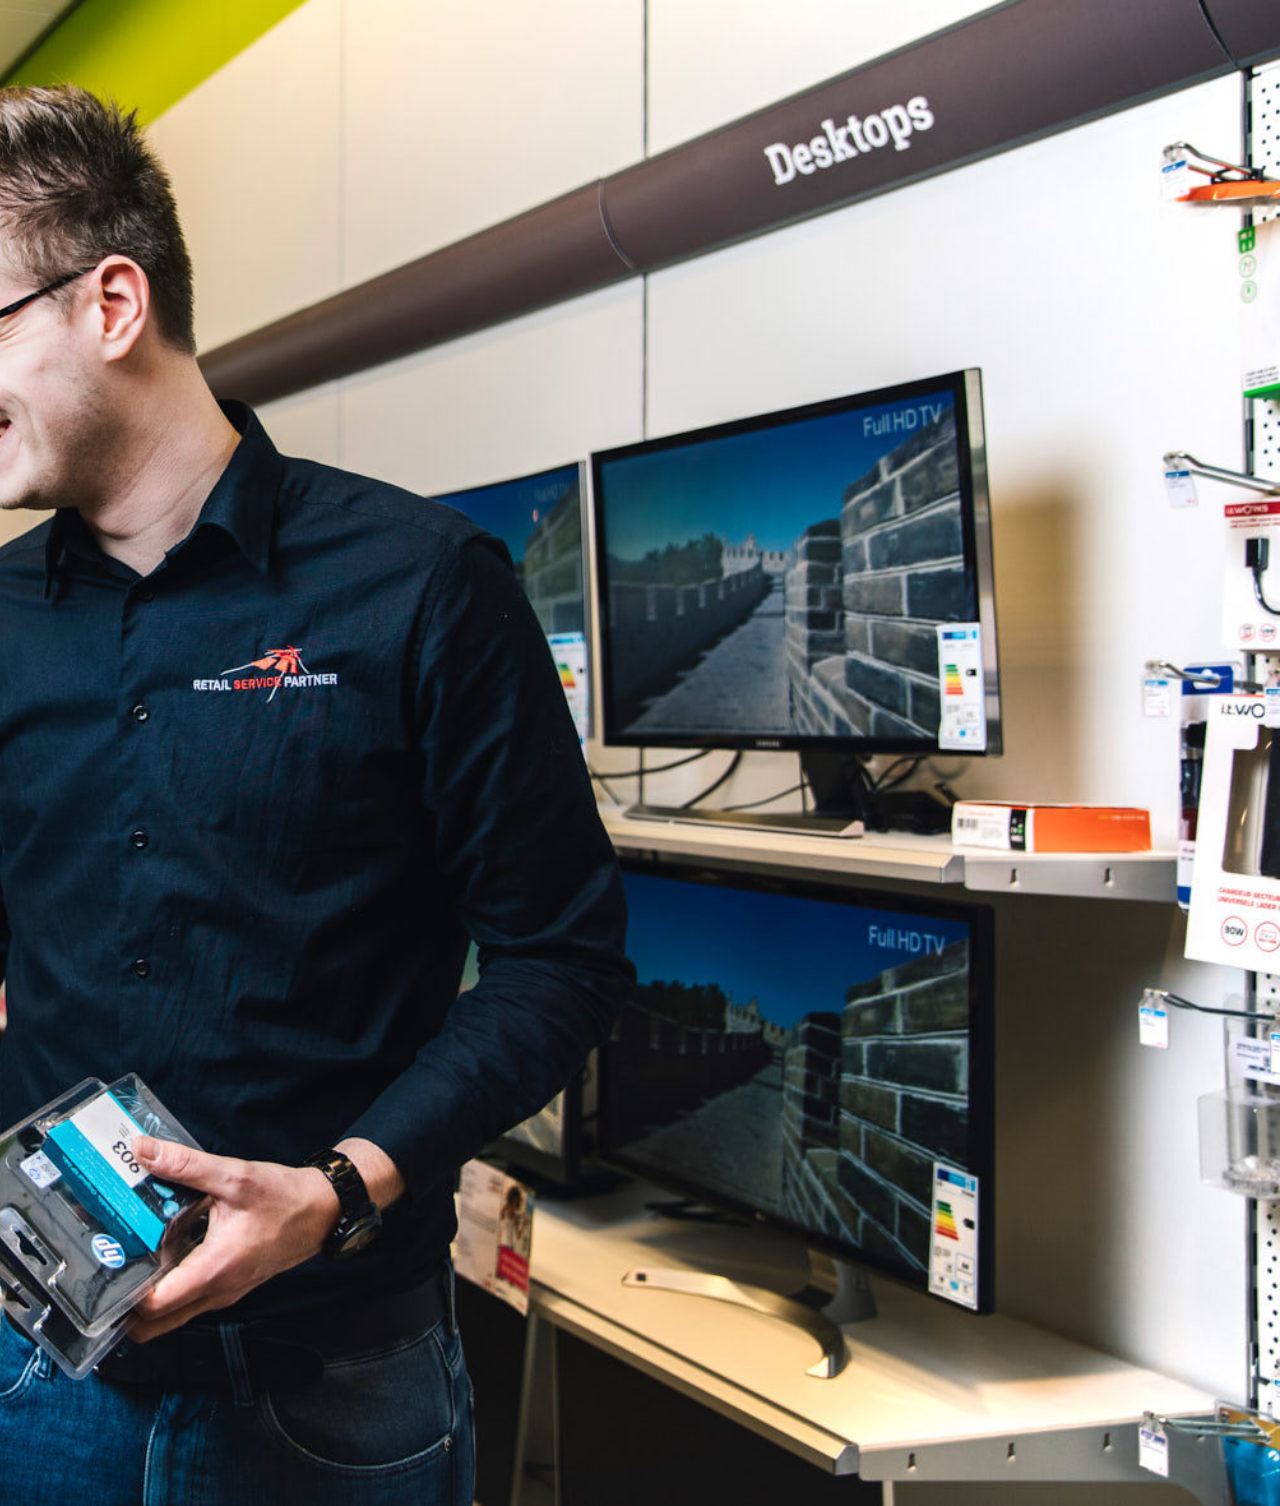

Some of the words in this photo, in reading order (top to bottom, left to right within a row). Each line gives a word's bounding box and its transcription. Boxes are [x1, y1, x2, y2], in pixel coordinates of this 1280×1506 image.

[764, 96, 934, 186] Desktops
[863, 414, 890, 438] Full
[892, 408, 918, 431] HD
[918, 403, 942, 427] TV
[193, 679, 232, 691] RETAIL
[233, 676, 282, 690] SERVICE
[284, 673, 338, 688] PARTNER
[868, 925, 895, 949] Full
[897, 930, 921, 953] HD
[923, 934, 945, 957] TV
[112, 1140, 140, 1174] 903
[94, 1237, 124, 1263] hp
